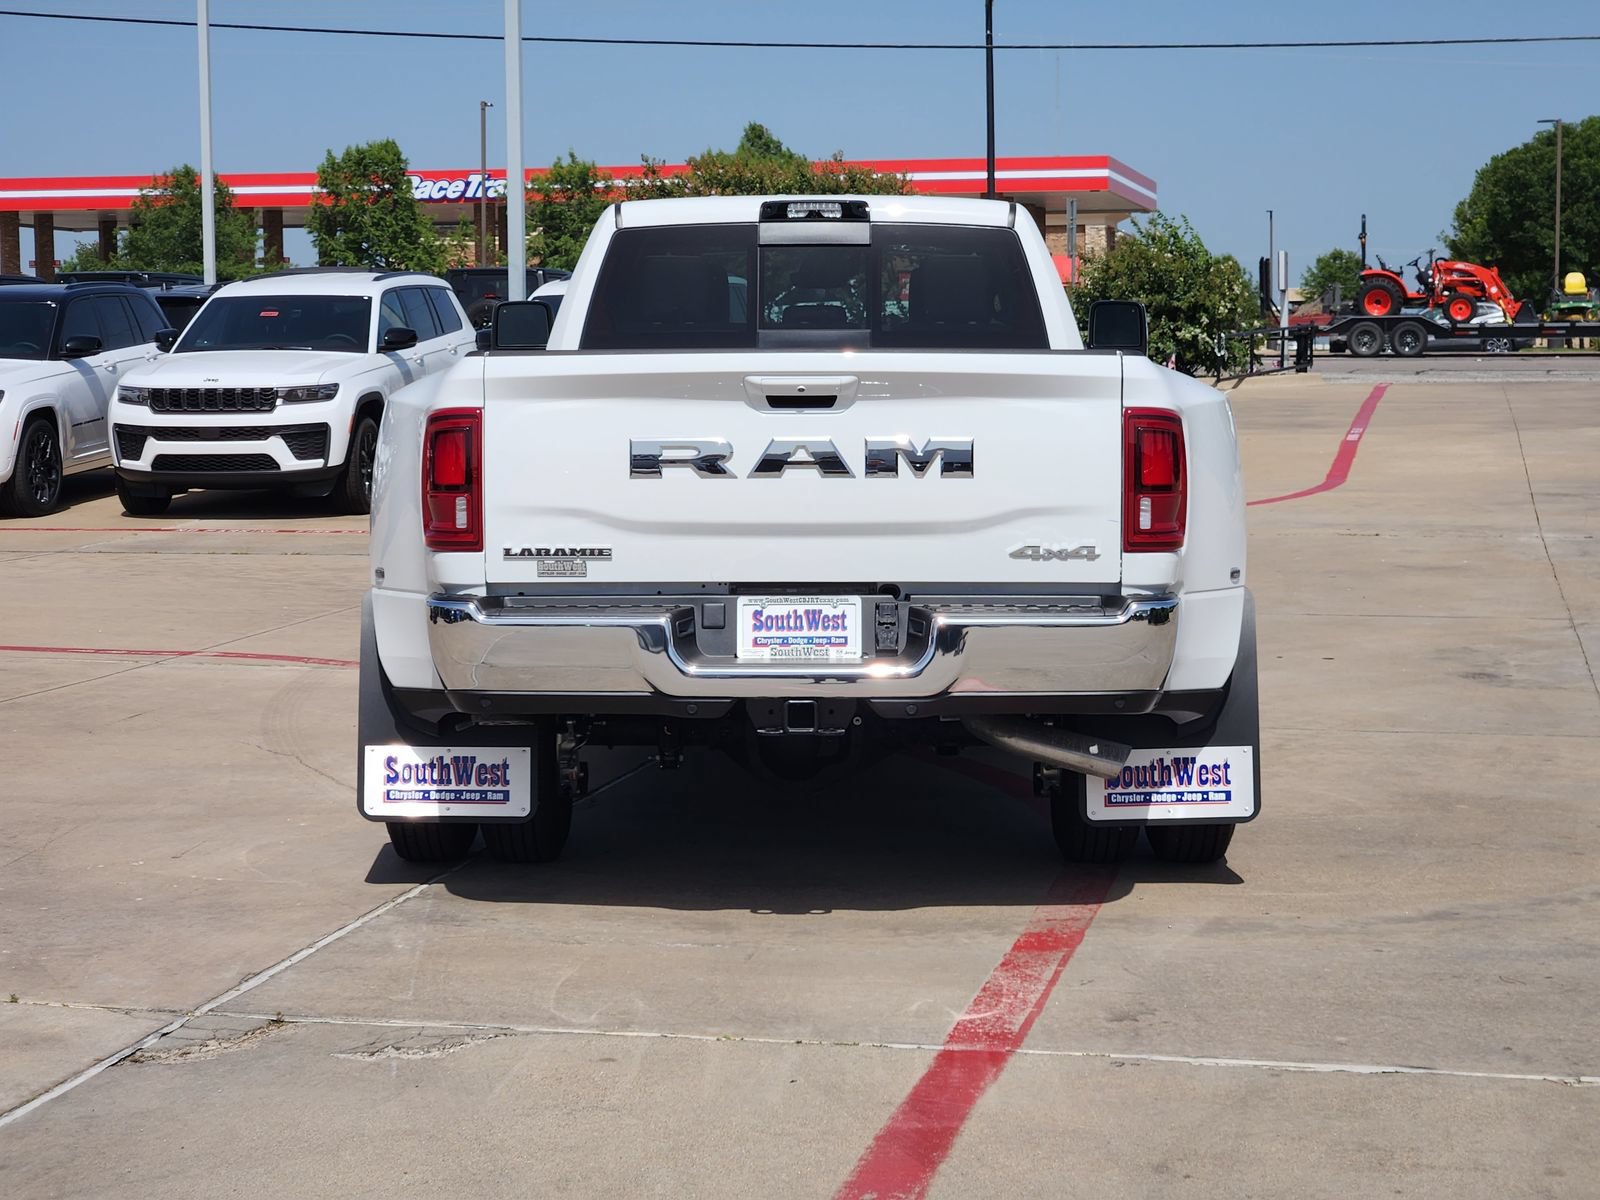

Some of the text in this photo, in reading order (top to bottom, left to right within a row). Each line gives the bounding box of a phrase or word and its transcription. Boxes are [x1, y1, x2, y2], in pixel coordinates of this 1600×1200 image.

[405, 174, 508, 199] aceTra
[629, 436, 974, 479] RAM
[503, 547, 612, 560] LARAMIE
[1008, 545, 1101, 562] 4x4
[537, 560, 587, 571] SouthWest
[752, 608, 848, 632] SouthWest
[756, 636, 846, 645] Chrysler Dodge Jeep Ram
[770, 647, 831, 657] SouthWest
[383, 755, 511, 787] SouthWest
[389, 790, 504, 801] Chrysler Dodge Jeep Ram
[1111, 791, 1227, 803] Chrysler Dodge Jeep Ram
